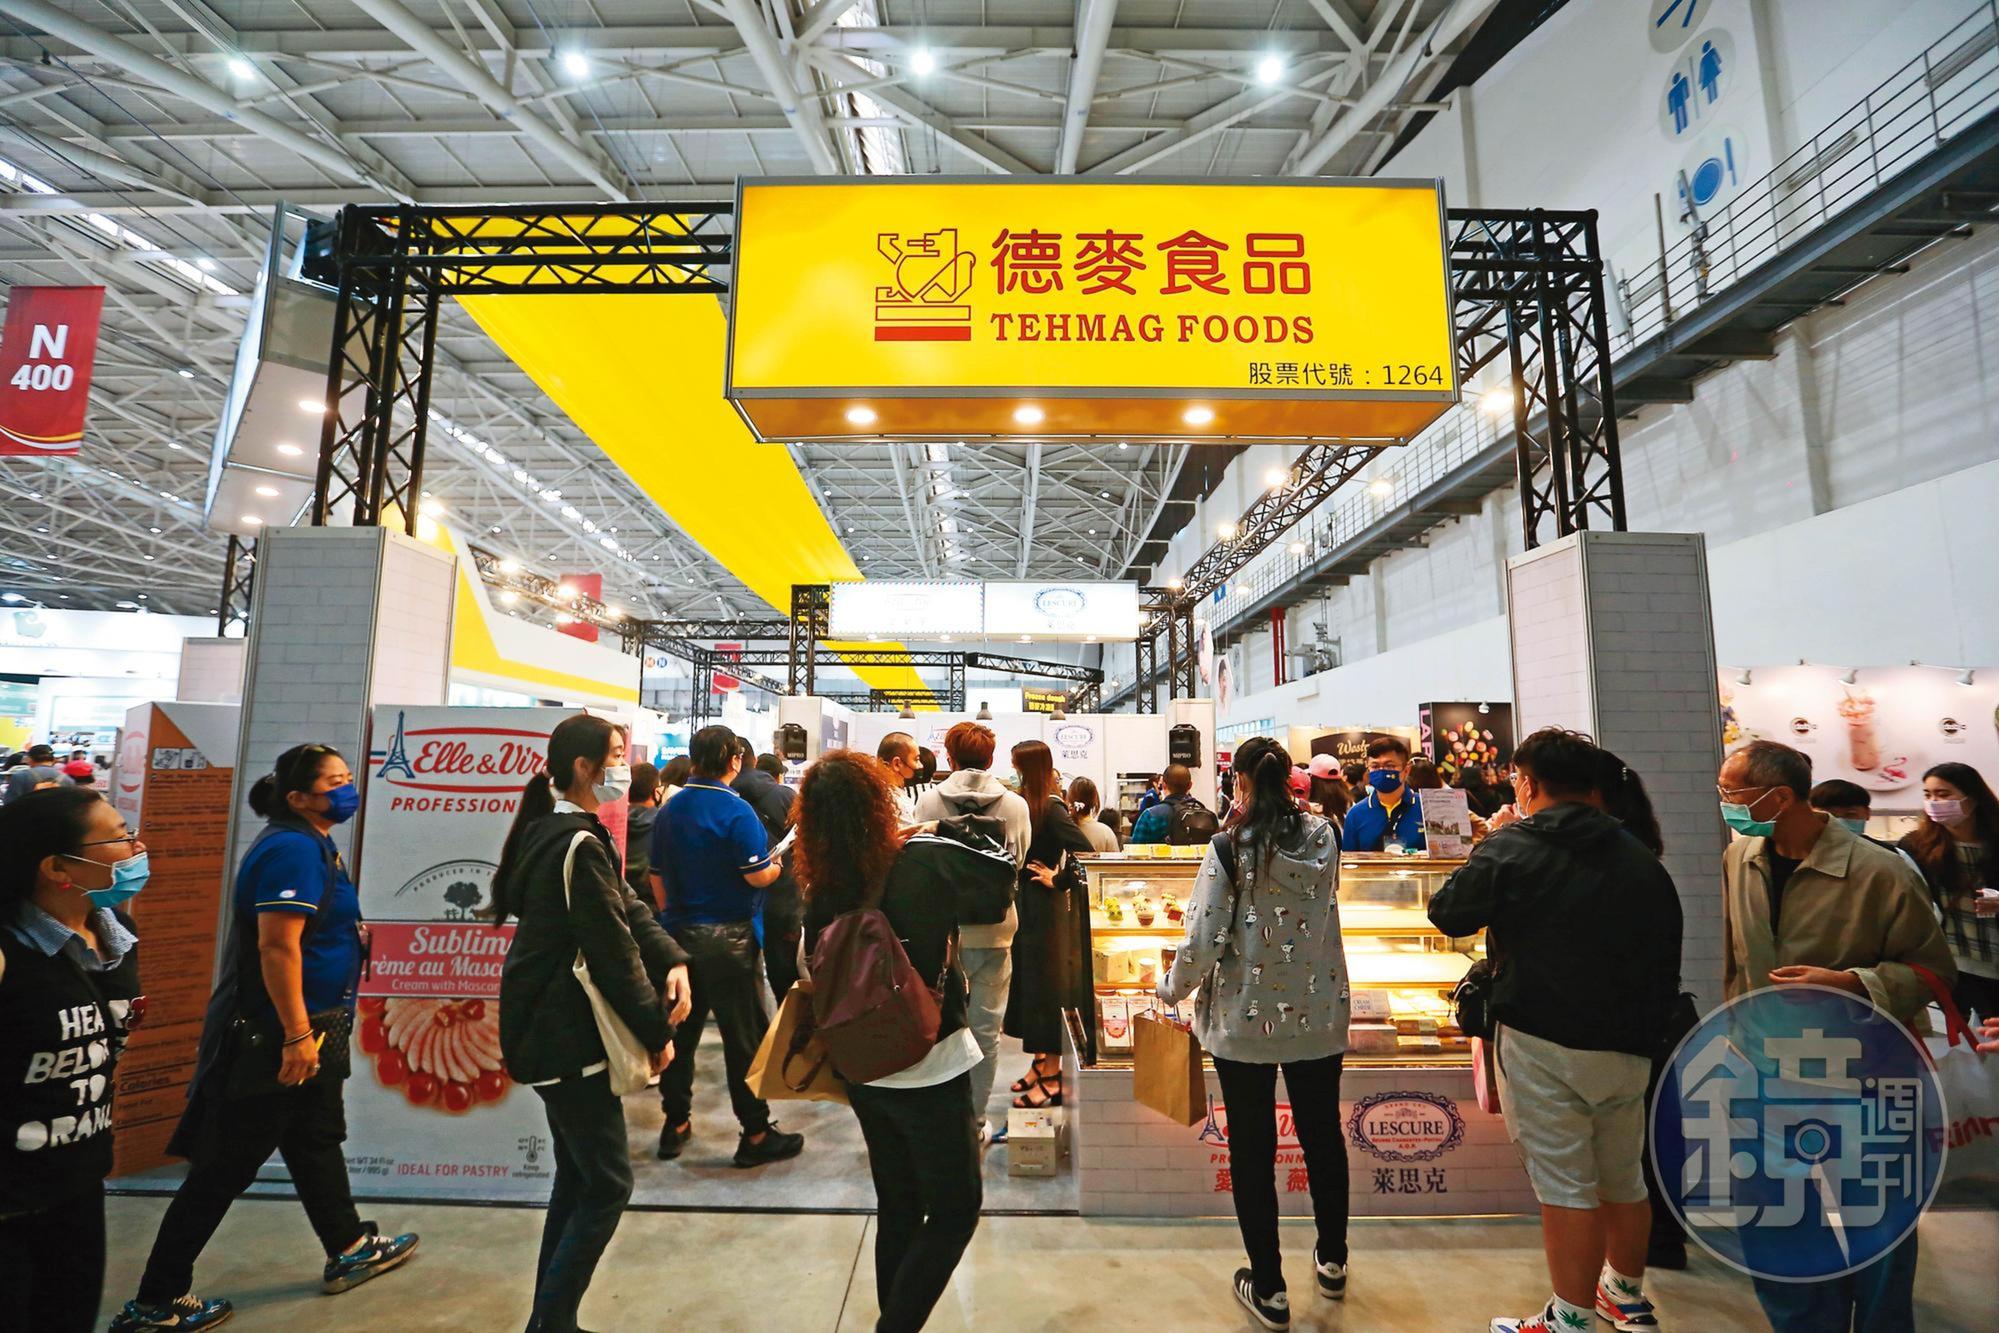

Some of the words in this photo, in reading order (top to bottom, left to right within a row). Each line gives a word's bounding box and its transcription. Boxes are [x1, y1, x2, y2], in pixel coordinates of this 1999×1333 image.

[991, 228, 1311, 295] 德麥食品
[29, 324, 69, 359] N
[990, 312, 1164, 342] TEHMAG
[1177, 314, 1314, 344] FOODS
[10, 364, 74, 391] 400
[391, 797, 522, 813] PROFESSION
[409, 926, 513, 956] Sublim
[361, 954, 414, 977] rème
[418, 961, 444, 977] au
[391, 978, 429, 992] Cream
[431, 979, 456, 991] with
[69, 1074, 107, 1106] TO
[1369, 1121, 1444, 1136] LESCURE
[398, 1163, 431, 1175] IDEAL
[435, 1164, 459, 1176] FOR
[462, 1165, 509, 1177] PASTRY
[1371, 1167, 1448, 1194] 萊思克
